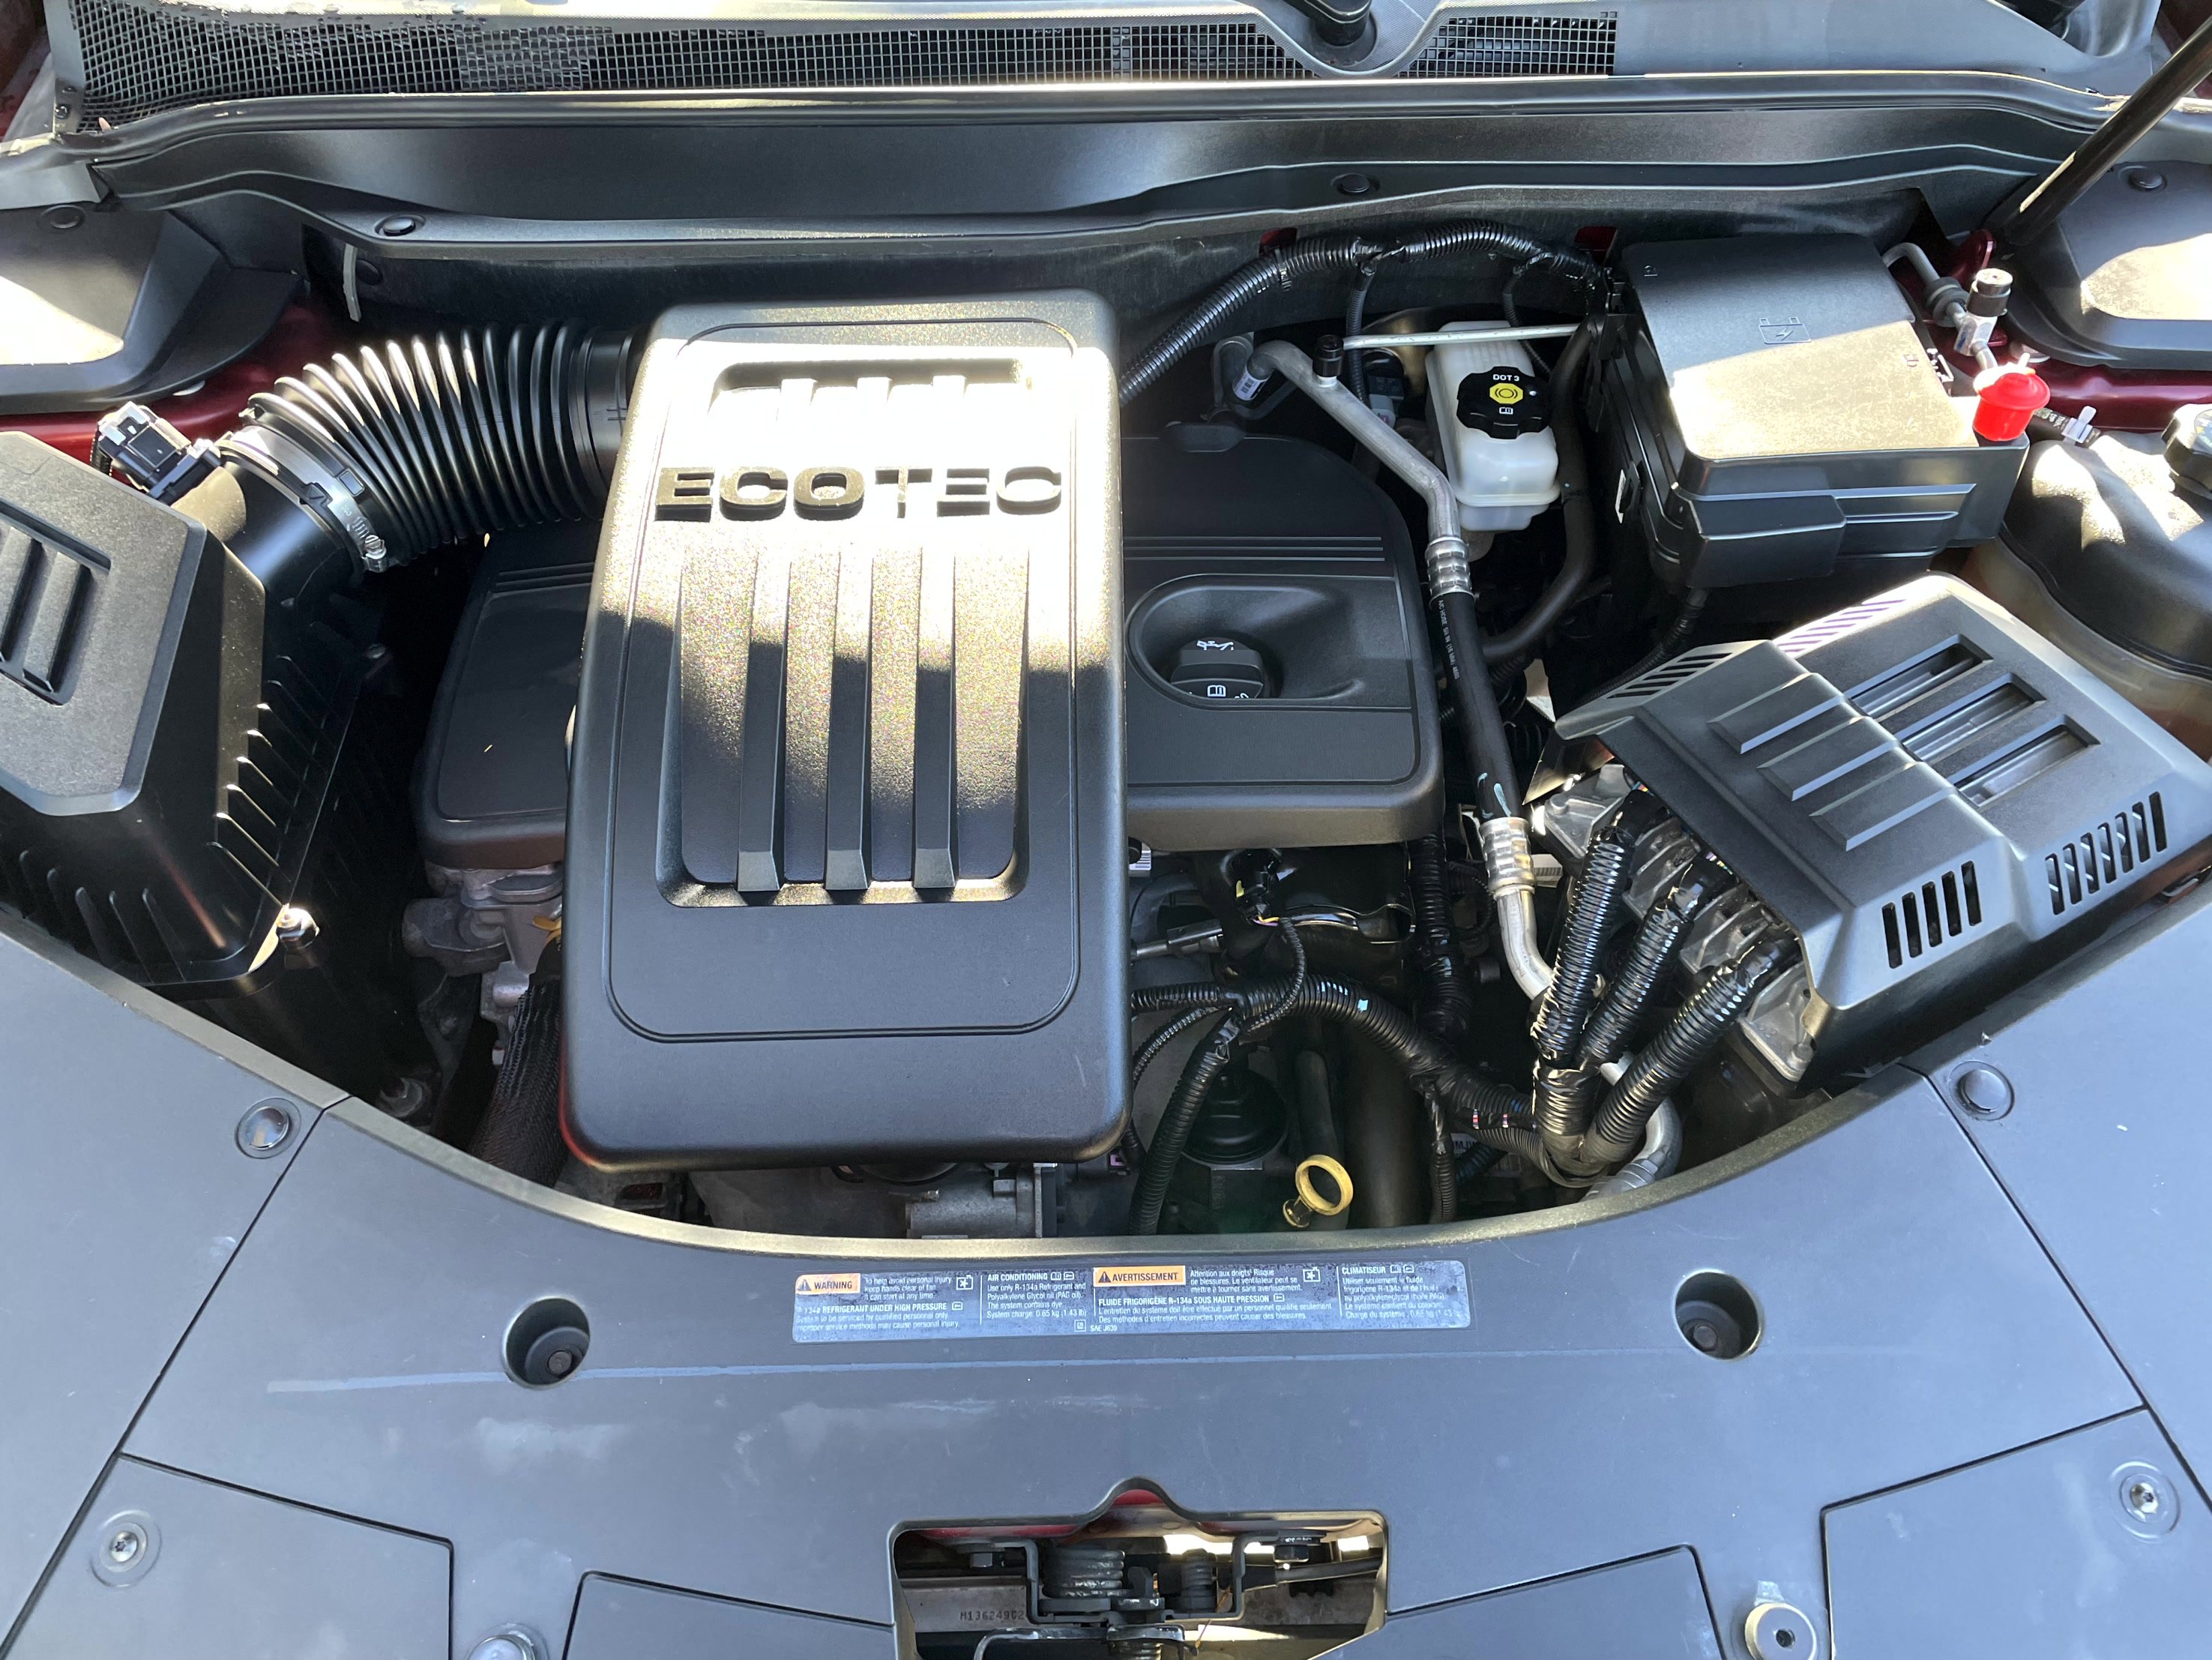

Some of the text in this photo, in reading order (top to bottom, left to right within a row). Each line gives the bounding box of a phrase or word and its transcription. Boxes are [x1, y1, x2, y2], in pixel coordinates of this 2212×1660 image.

[654, 466, 1062, 523] ECOTEC
[1253, 1269, 1274, 1277] Risque
[1342, 1266, 1386, 1275] CLIMATISEUR
[907, 1276, 933, 1284] personal
[1112, 1272, 1178, 1281] AVERTISSEMENT
[1365, 1276, 1398, 1284] seulement
[814, 1281, 852, 1290] WARNING
[1001, 1284, 1013, 1293] only
[987, 1293, 1025, 1301] Polyalkylene
[1027, 1292, 1045, 1300] Glycol
[1055, 1291, 1070, 1299] (PAG
[1098, 1295, 1270, 1306] FLUIDE FRIGORIGÈNE R-134a SOUS HAUTE PRESSION
[822, 1305, 869, 1314] REFRIGERANT
[870, 1304, 893, 1312] UNDER
[894, 1303, 911, 1311] HIGH
[912, 1302, 947, 1311] PRESSURE
[1001, 1302, 1022, 1310] system
[1098, 1307, 1130, 1315] L'entretien
[1244, 1304, 1274, 1312] personnel
[876, 1313, 901, 1321] qualified
[903, 1312, 934, 1321] personnel
[986, 1311, 1010, 1320] System
[1052, 1309, 1060, 1318] kg
[1079, 1309, 1087, 1317] lb)
[1214, 1313, 1239, 1321] peuvent
[849, 1322, 876, 1330] methods
[878, 1322, 892, 1330] may
[913, 1320, 940, 1329] personal
